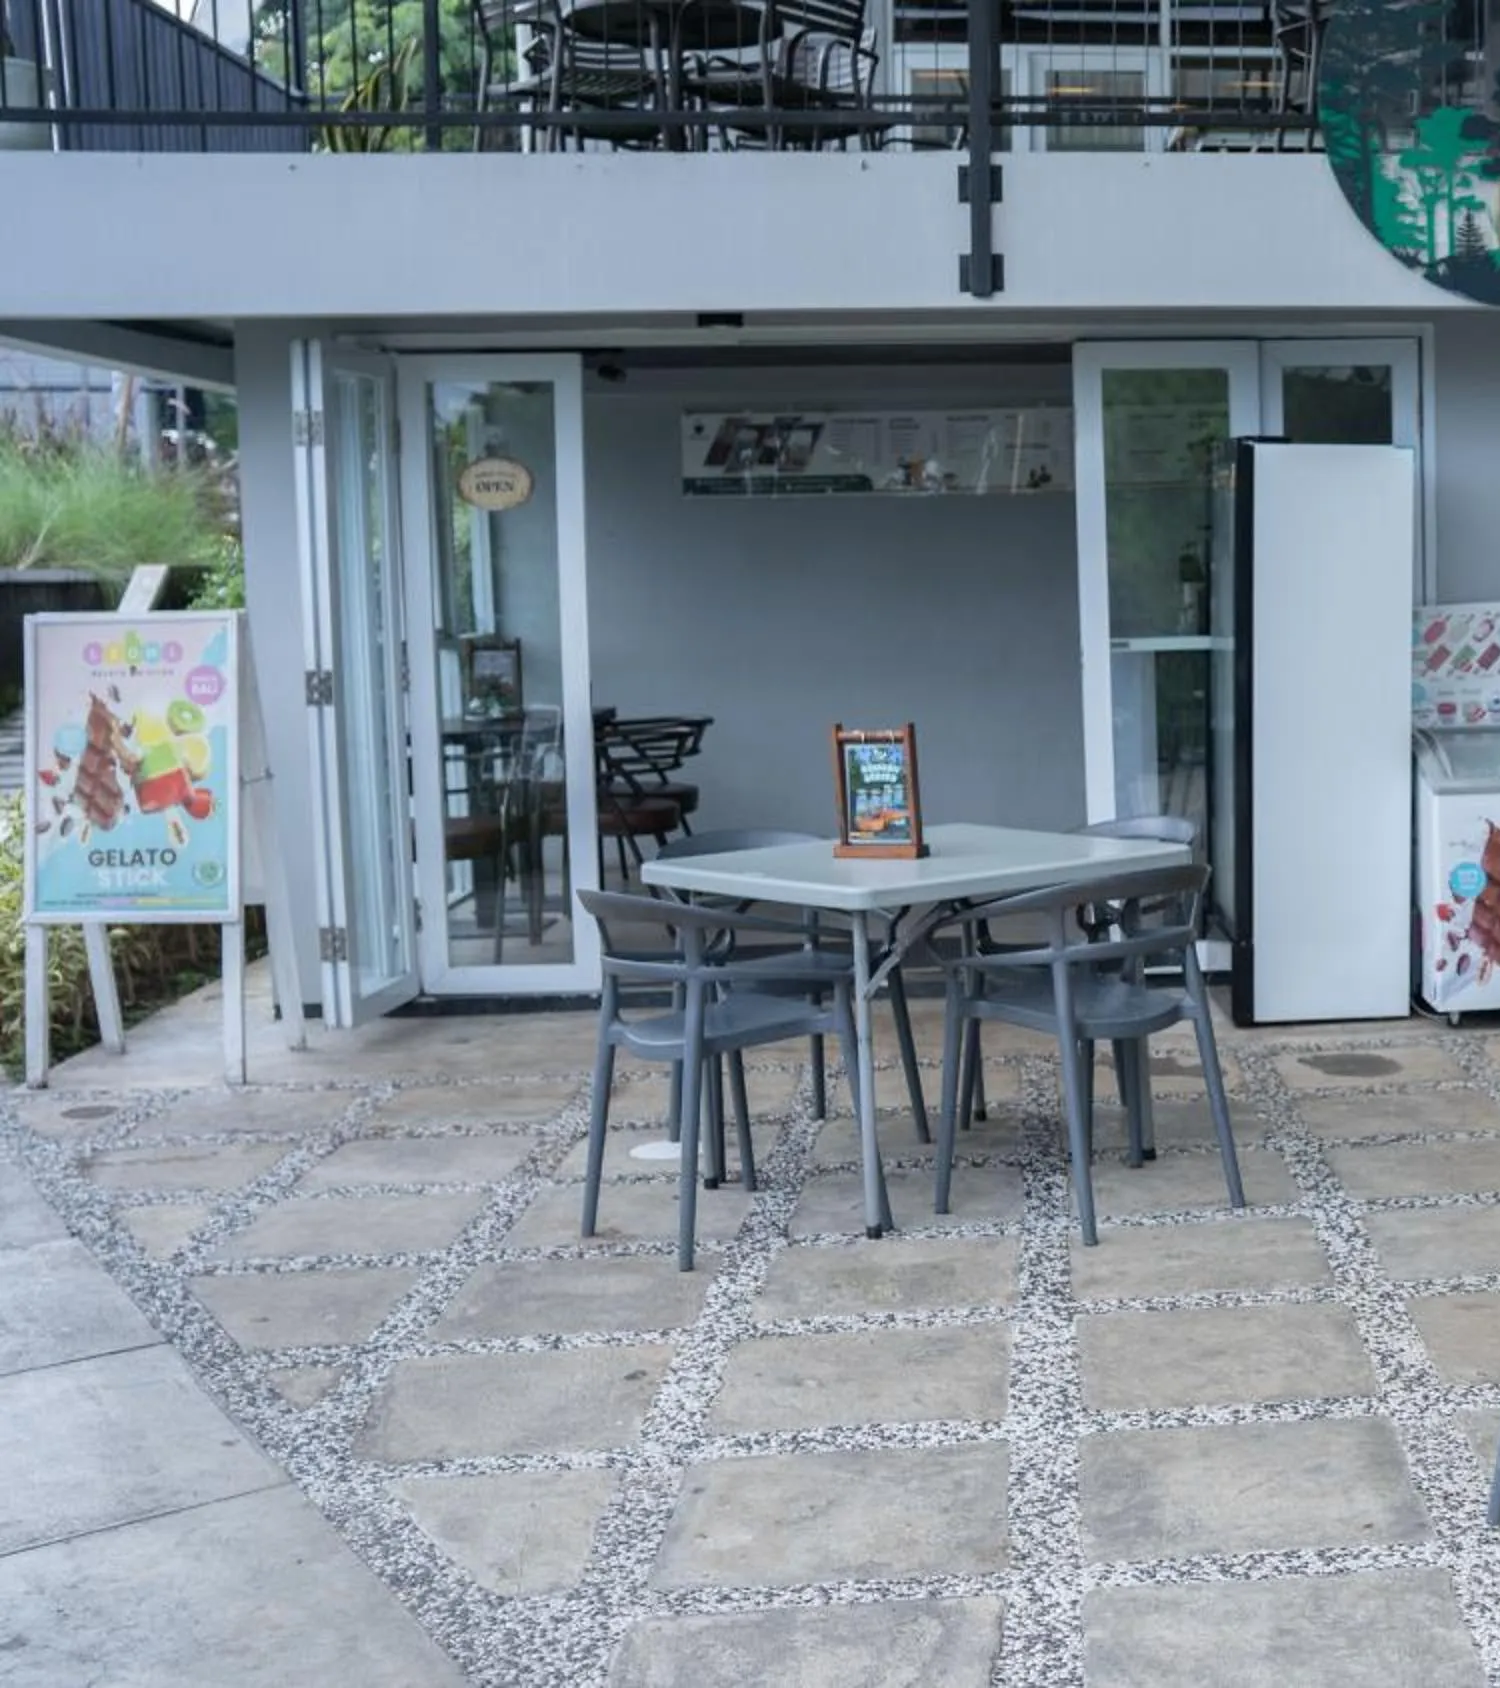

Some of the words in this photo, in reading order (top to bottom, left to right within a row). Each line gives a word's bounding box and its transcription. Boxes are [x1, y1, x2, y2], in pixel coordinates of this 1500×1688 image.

[476, 480, 514, 492] OPEN
[88, 848, 177, 867] GELATO
[97, 869, 168, 887] STICK
